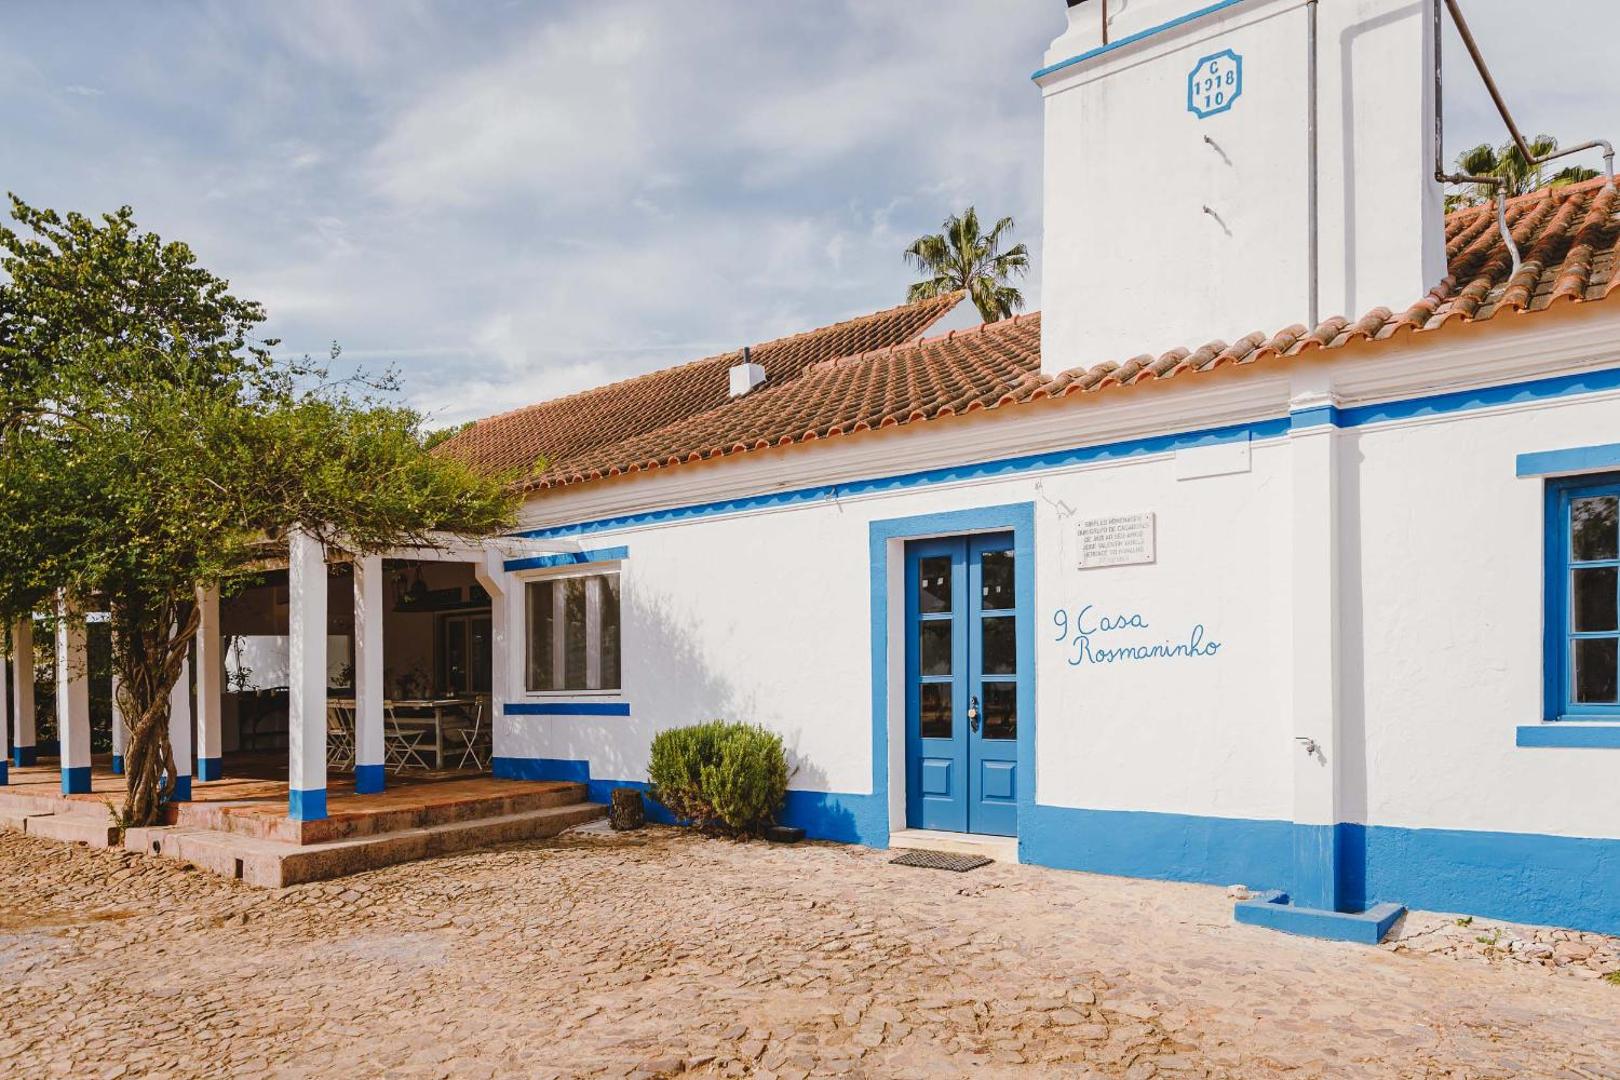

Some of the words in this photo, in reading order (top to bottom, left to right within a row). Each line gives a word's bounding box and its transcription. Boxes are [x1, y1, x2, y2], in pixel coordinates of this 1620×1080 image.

[1204, 91, 1224, 108] 10
[1078, 604, 1149, 635] Casa
[1067, 624, 1222, 666] Rosmaninho
